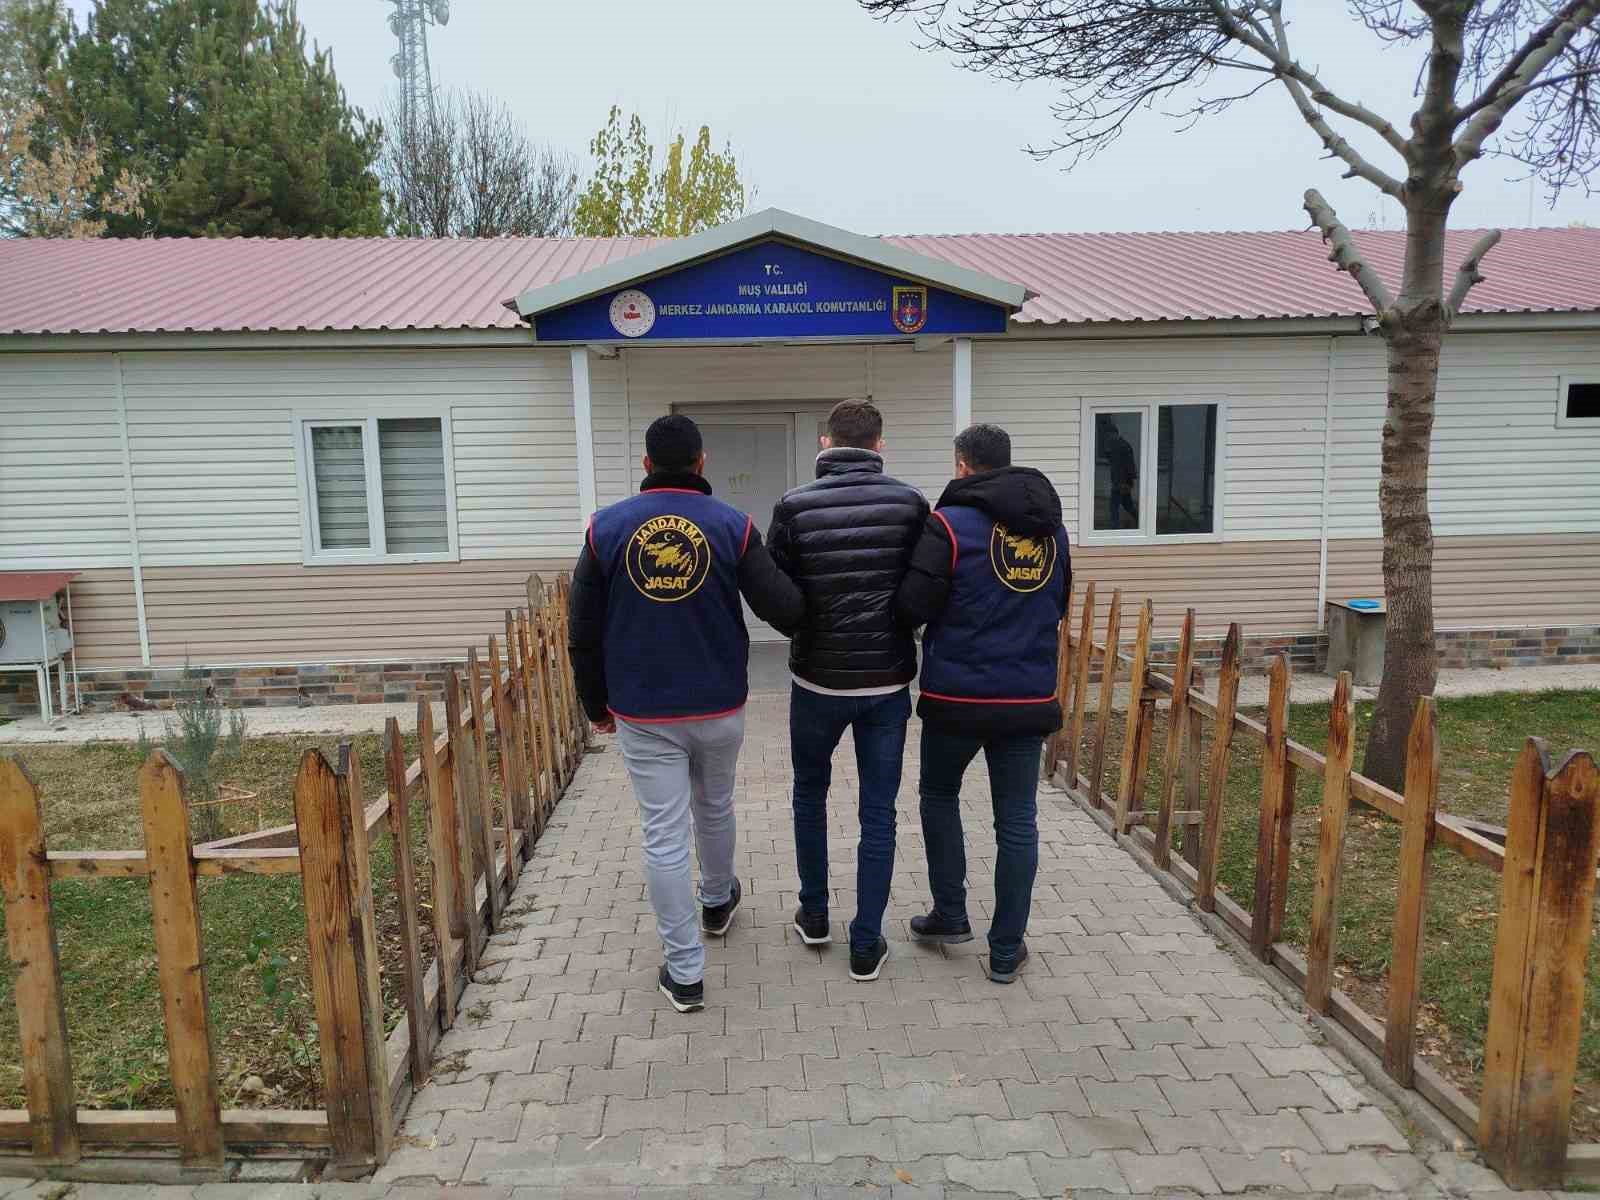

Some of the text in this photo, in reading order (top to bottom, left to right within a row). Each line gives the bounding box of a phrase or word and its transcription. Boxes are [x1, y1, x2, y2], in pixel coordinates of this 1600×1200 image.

[738, 284, 761, 298] MUŞ
[659, 299, 887, 316] MERKEZ JANDARMA KARAKOL KOMUTANLIĞI
[635, 517, 704, 547] JANDARMA
[1006, 567, 1042, 580] JASAT
[644, 576, 690, 590] JASAT
